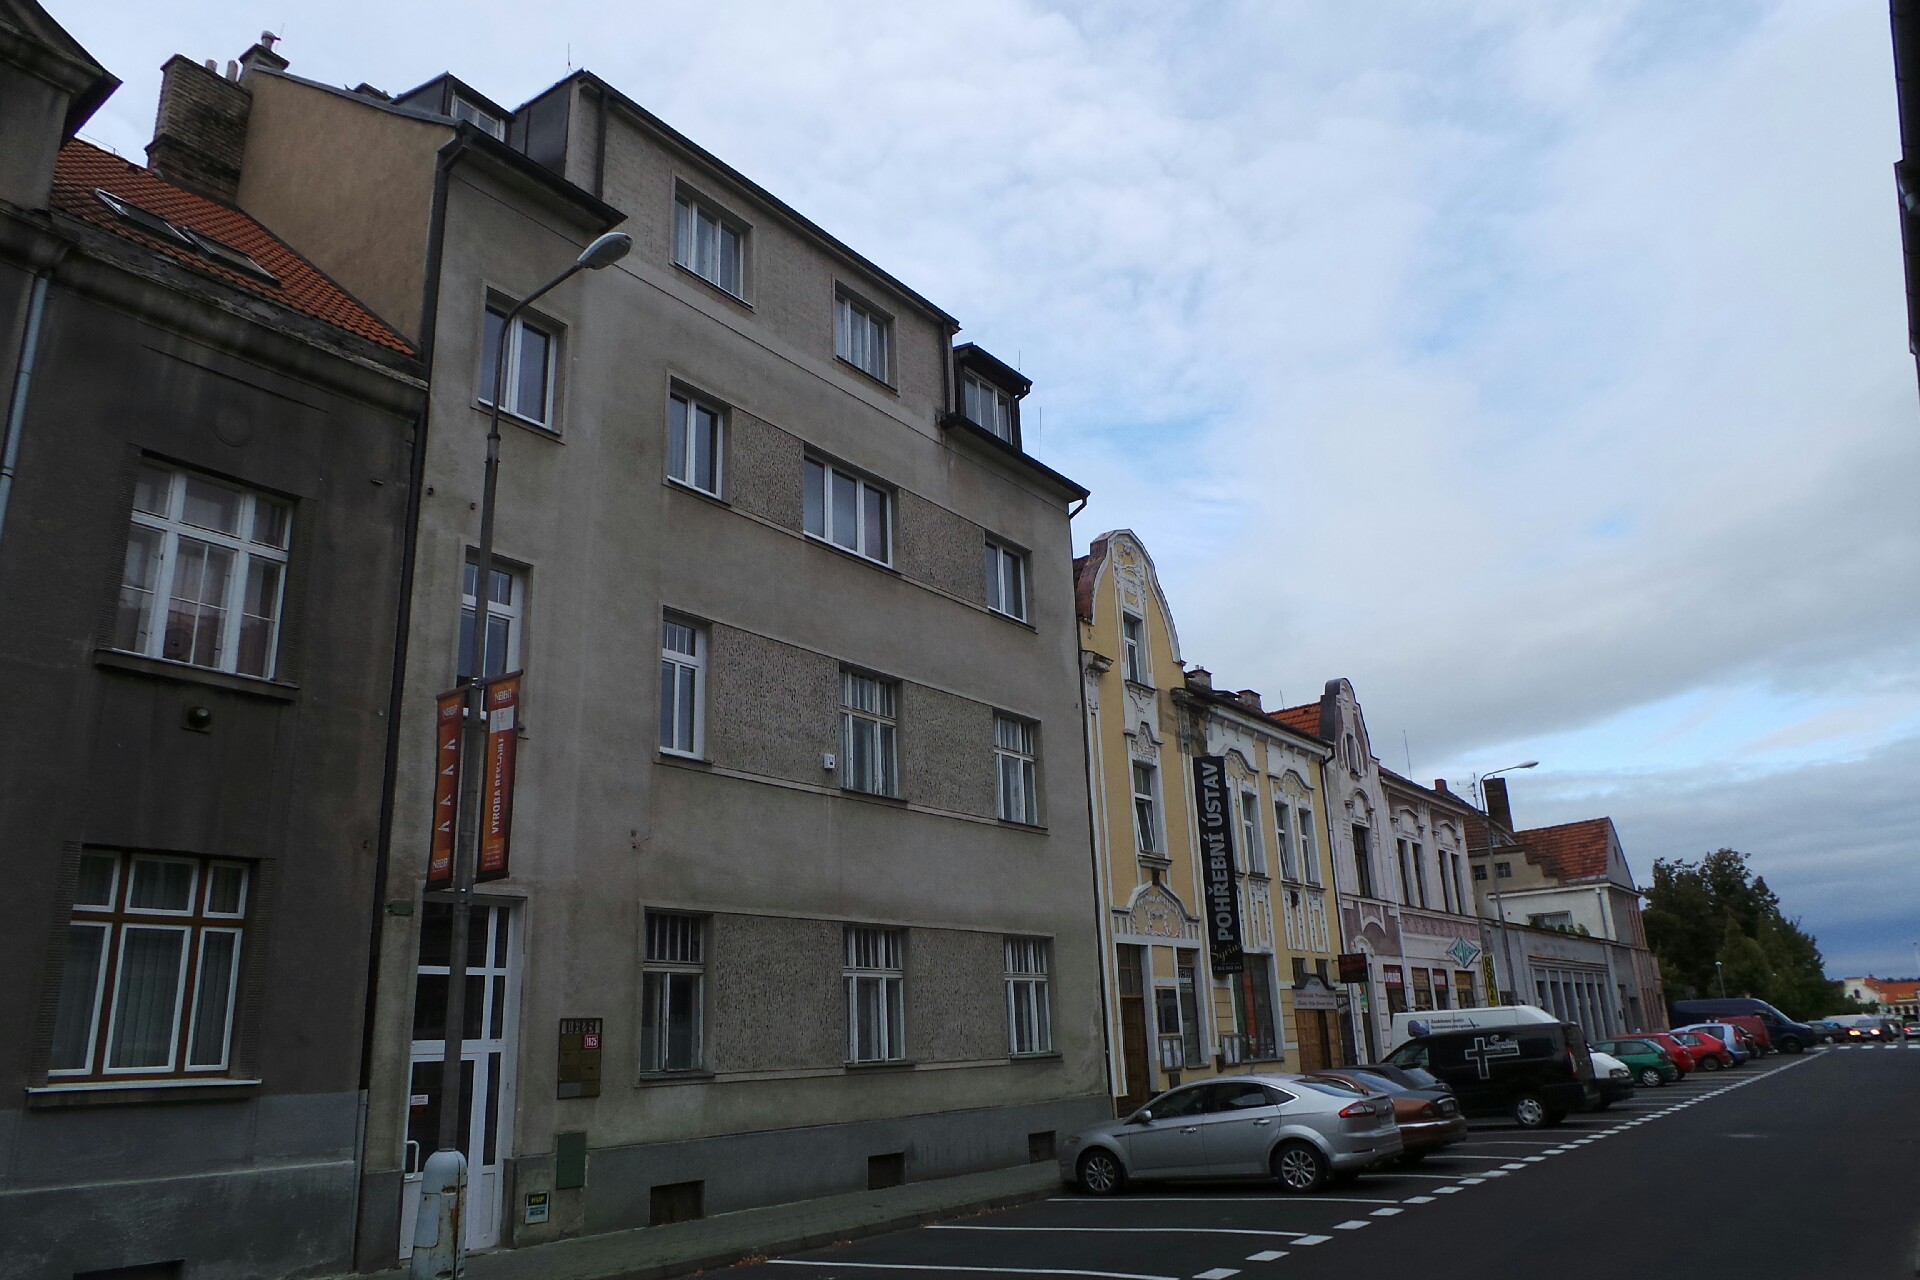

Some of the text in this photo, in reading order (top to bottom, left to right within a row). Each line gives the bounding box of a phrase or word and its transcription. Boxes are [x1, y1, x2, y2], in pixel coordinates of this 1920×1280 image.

[494, 737, 504, 787] REKLAMY
[491, 789, 501, 834] VÝROBA
[1201, 763, 1223, 827] ÚSTAV
[1203, 832, 1234, 940] POHŘEBNÍ
